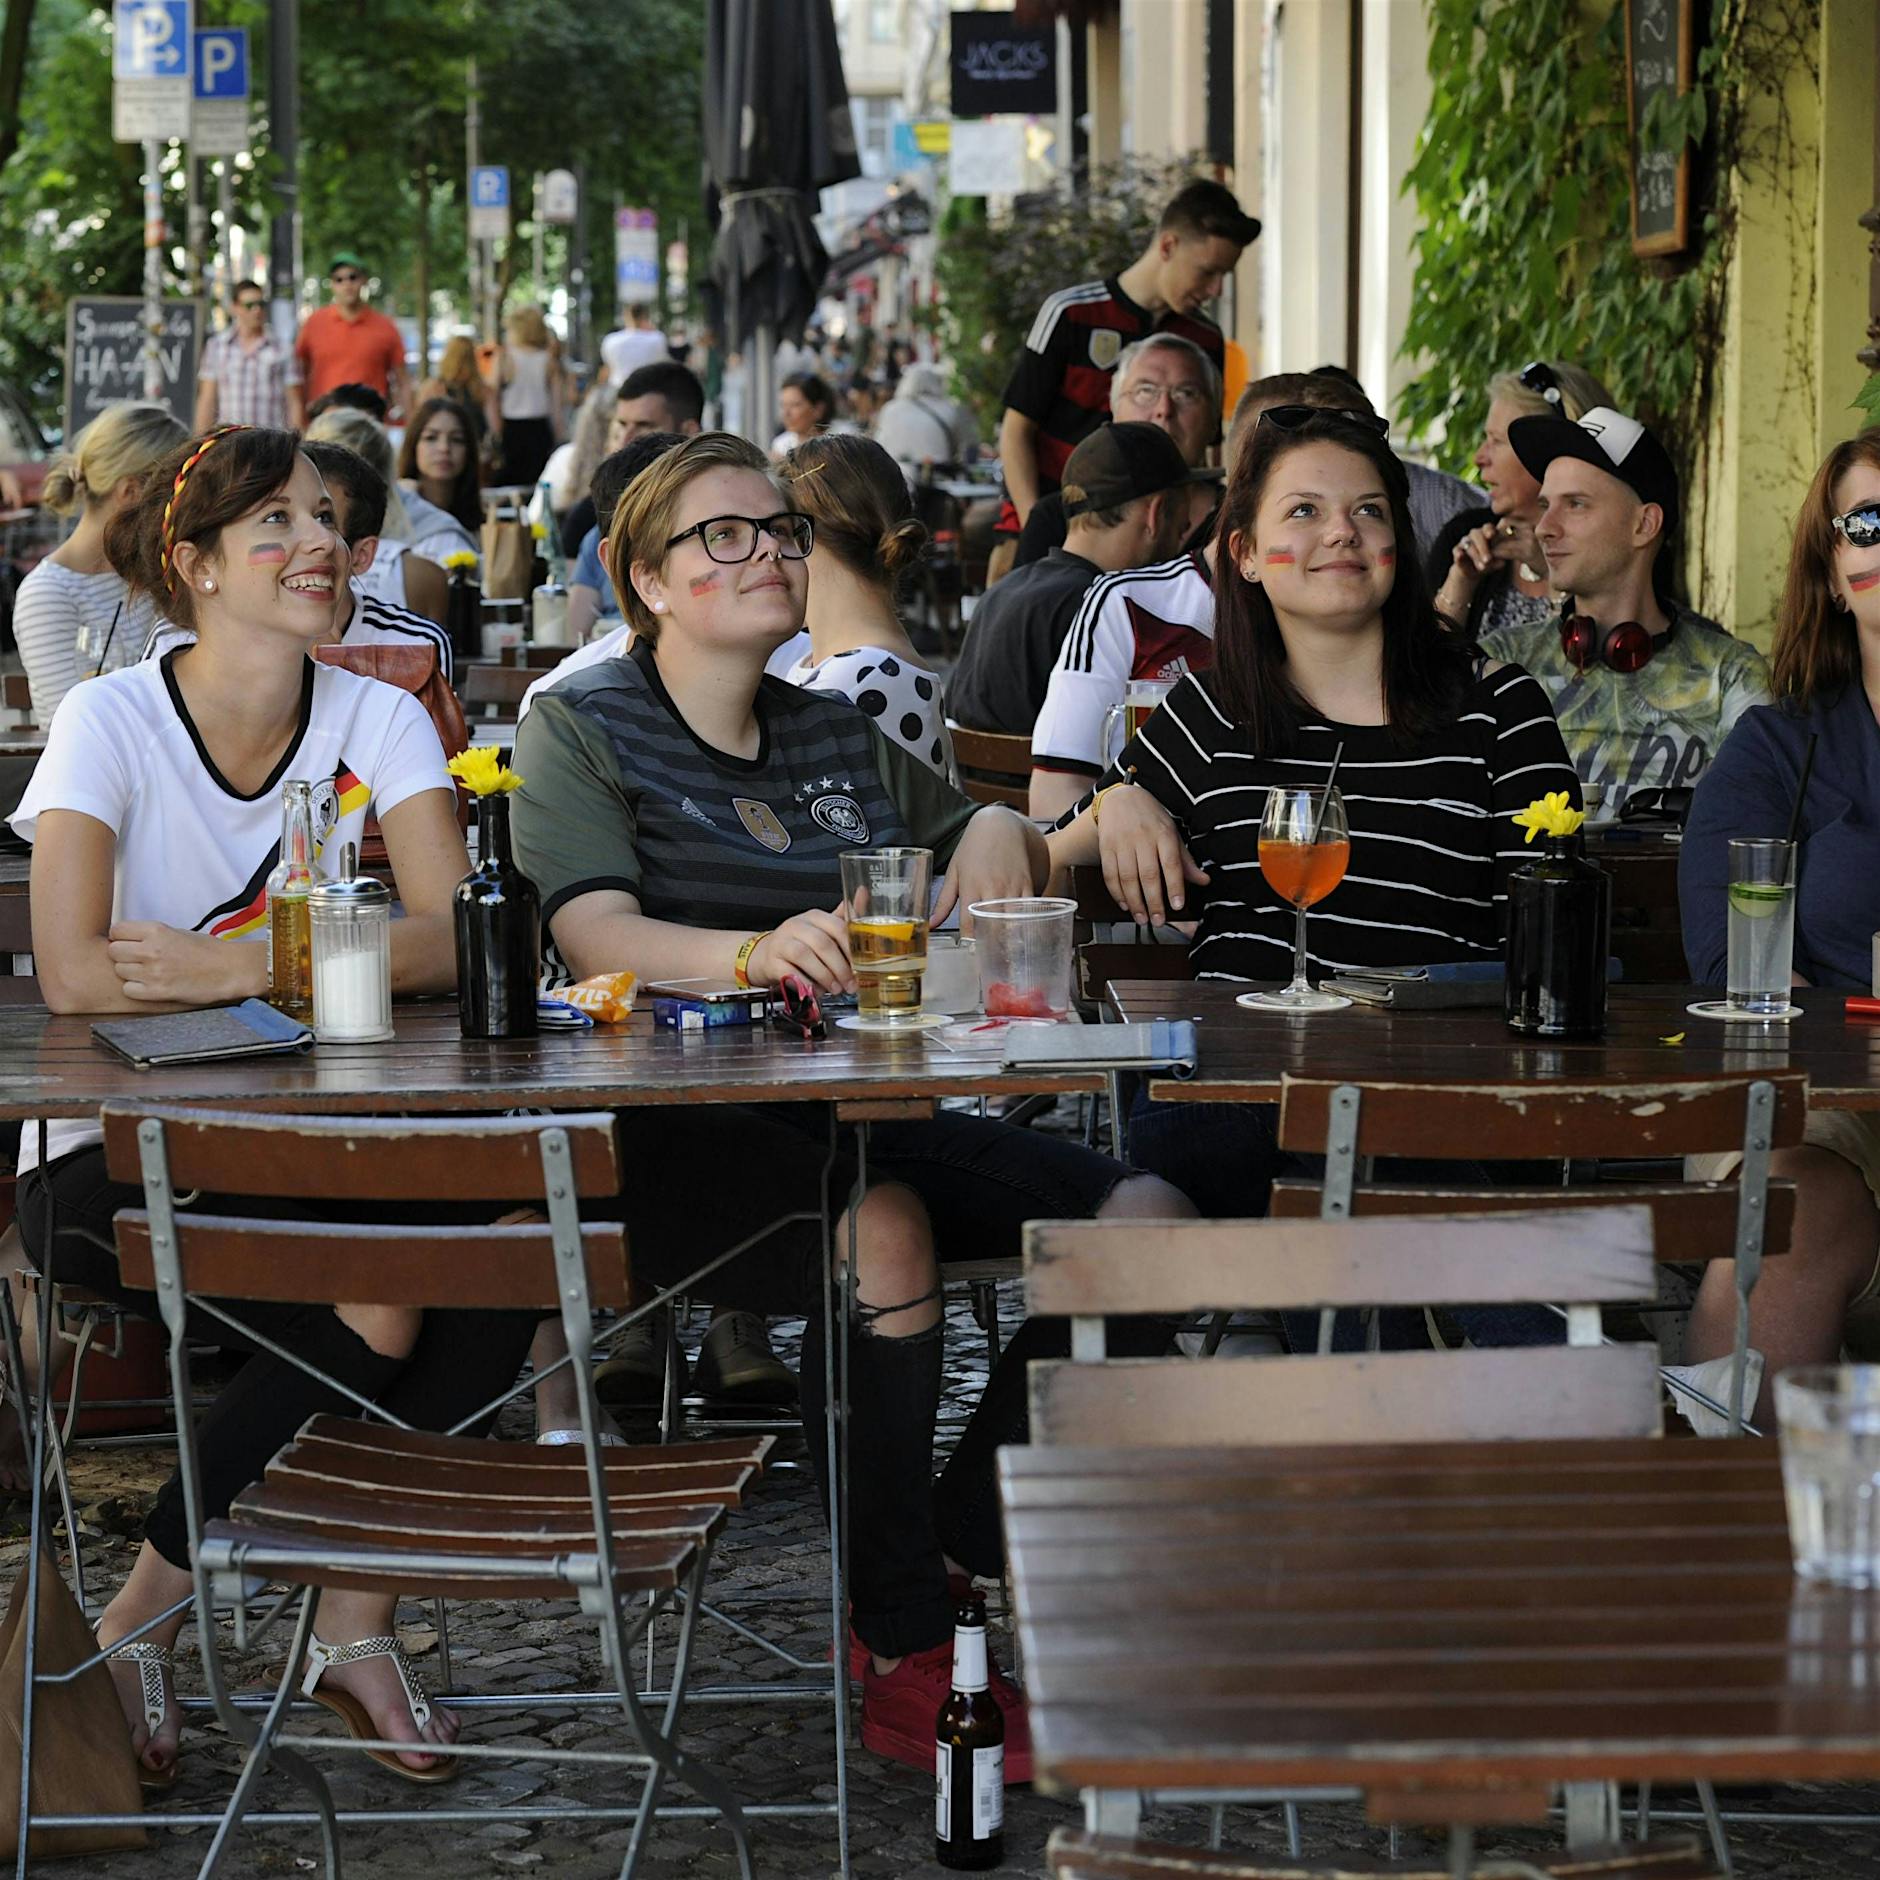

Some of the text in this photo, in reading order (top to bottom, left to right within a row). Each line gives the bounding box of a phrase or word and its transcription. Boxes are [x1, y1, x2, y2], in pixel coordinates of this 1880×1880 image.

[132, 7, 174, 70] P
[959, 40, 1049, 71] JACKS
[202, 36, 237, 93] P
[1157, 669, 1184, 679] adid
